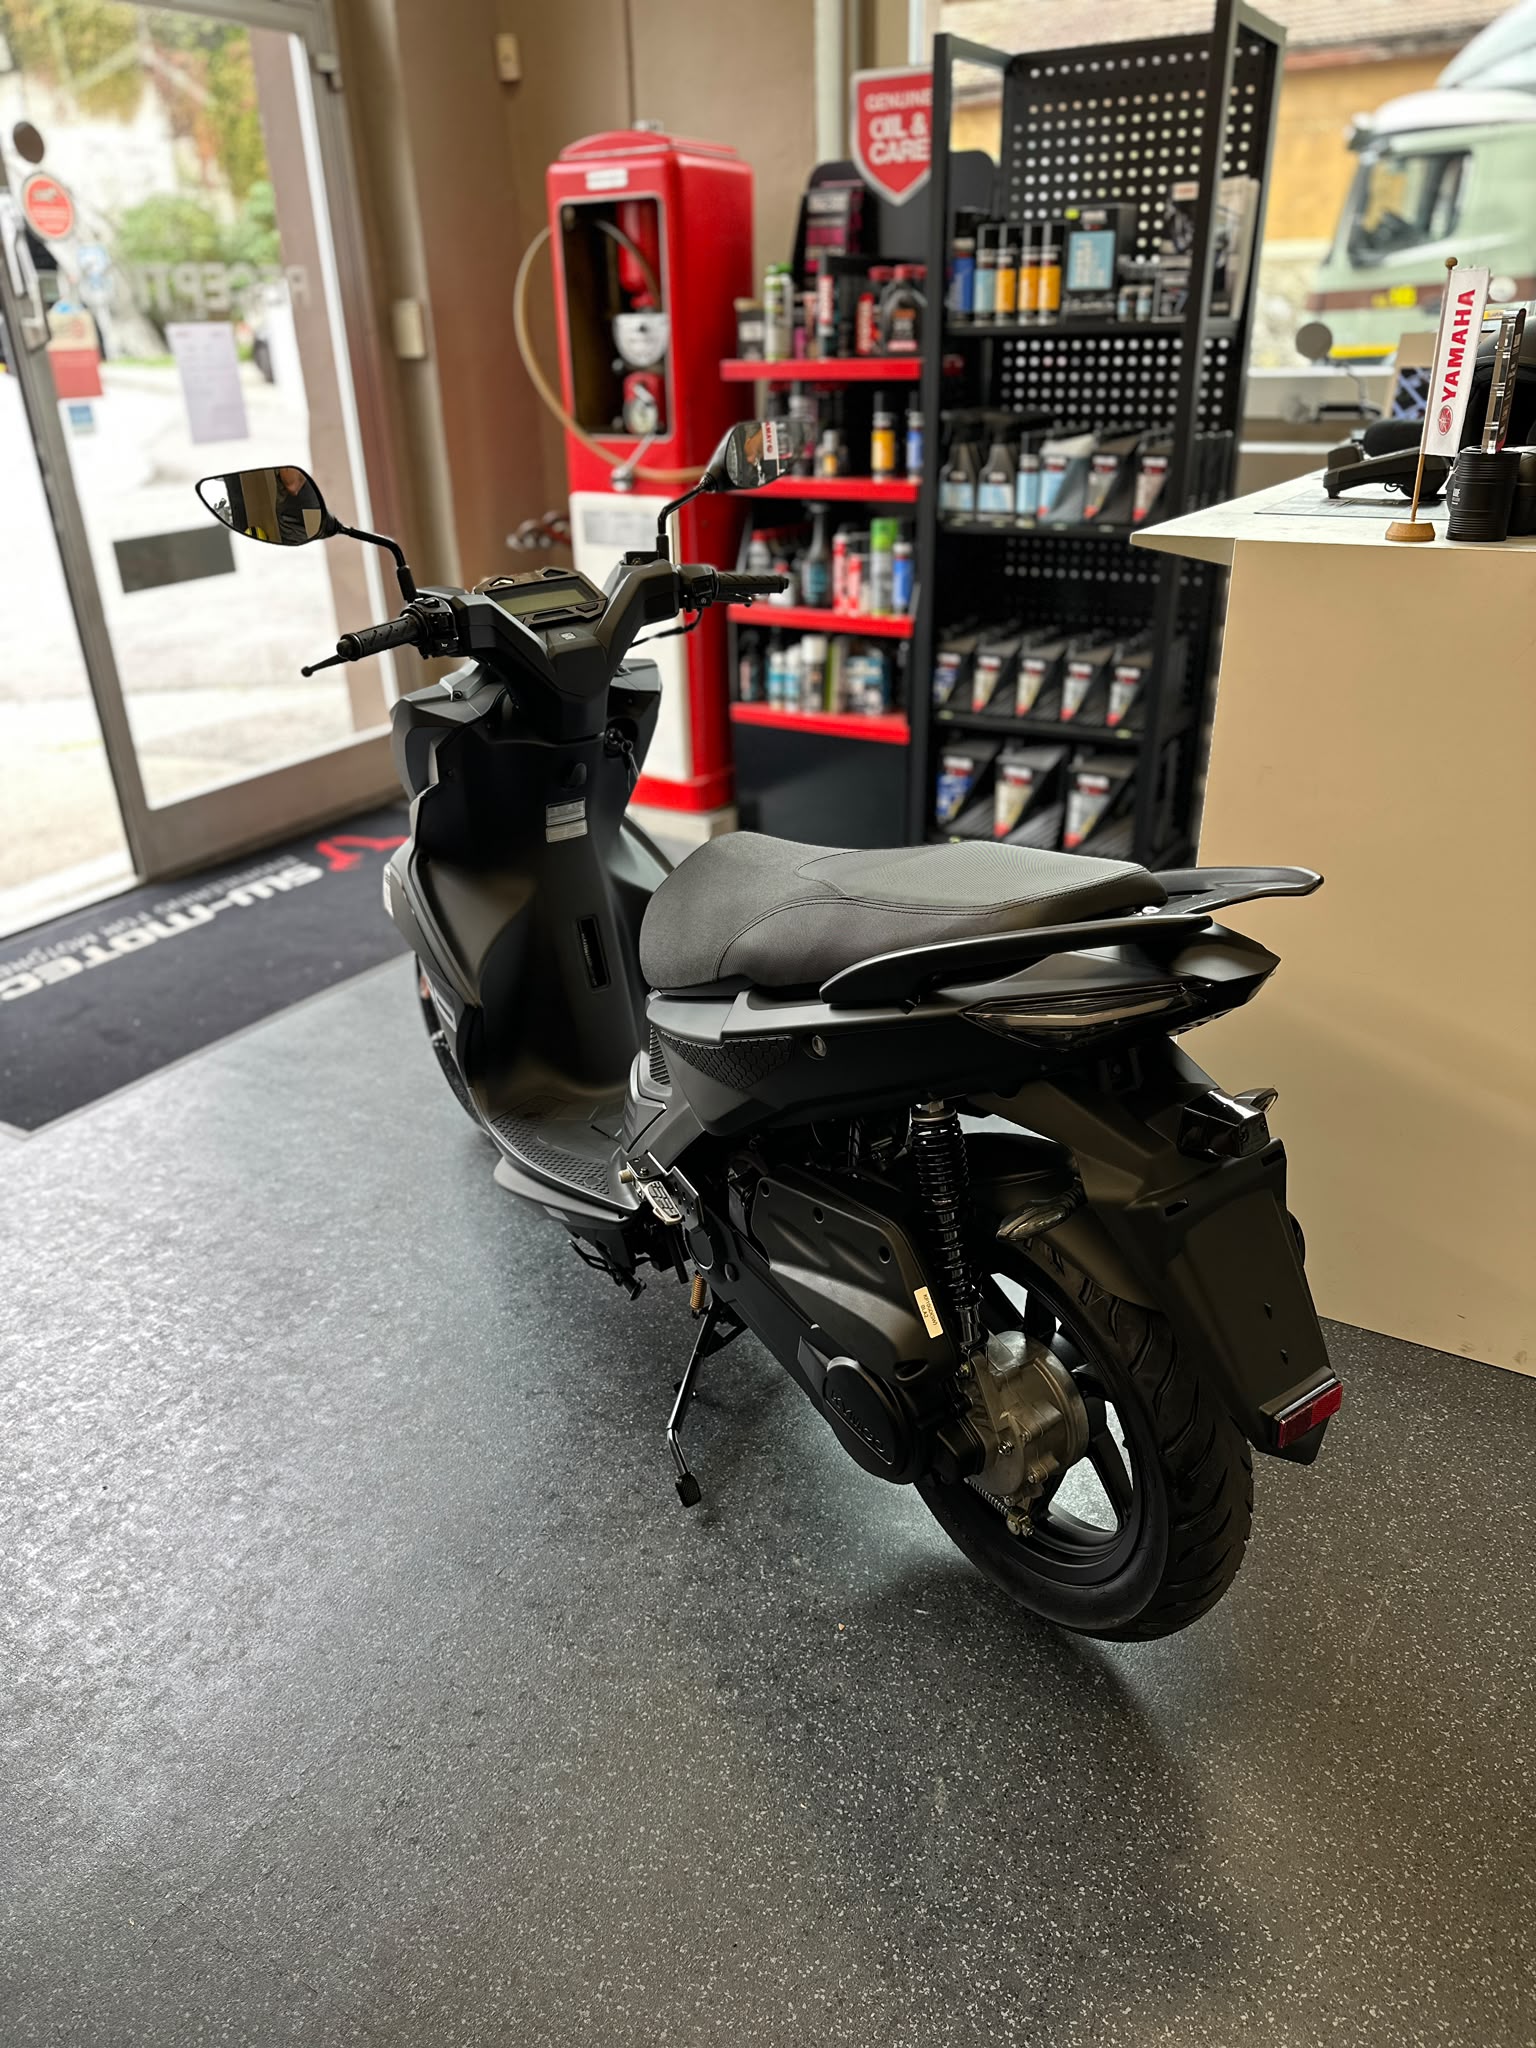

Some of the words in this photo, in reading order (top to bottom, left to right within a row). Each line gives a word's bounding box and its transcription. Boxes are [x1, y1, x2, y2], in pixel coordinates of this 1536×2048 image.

[868, 113, 909, 141] OIL
[909, 111, 930, 137] &
[867, 138, 932, 165] CARE
[1441, 289, 1476, 403] YAMAHA
